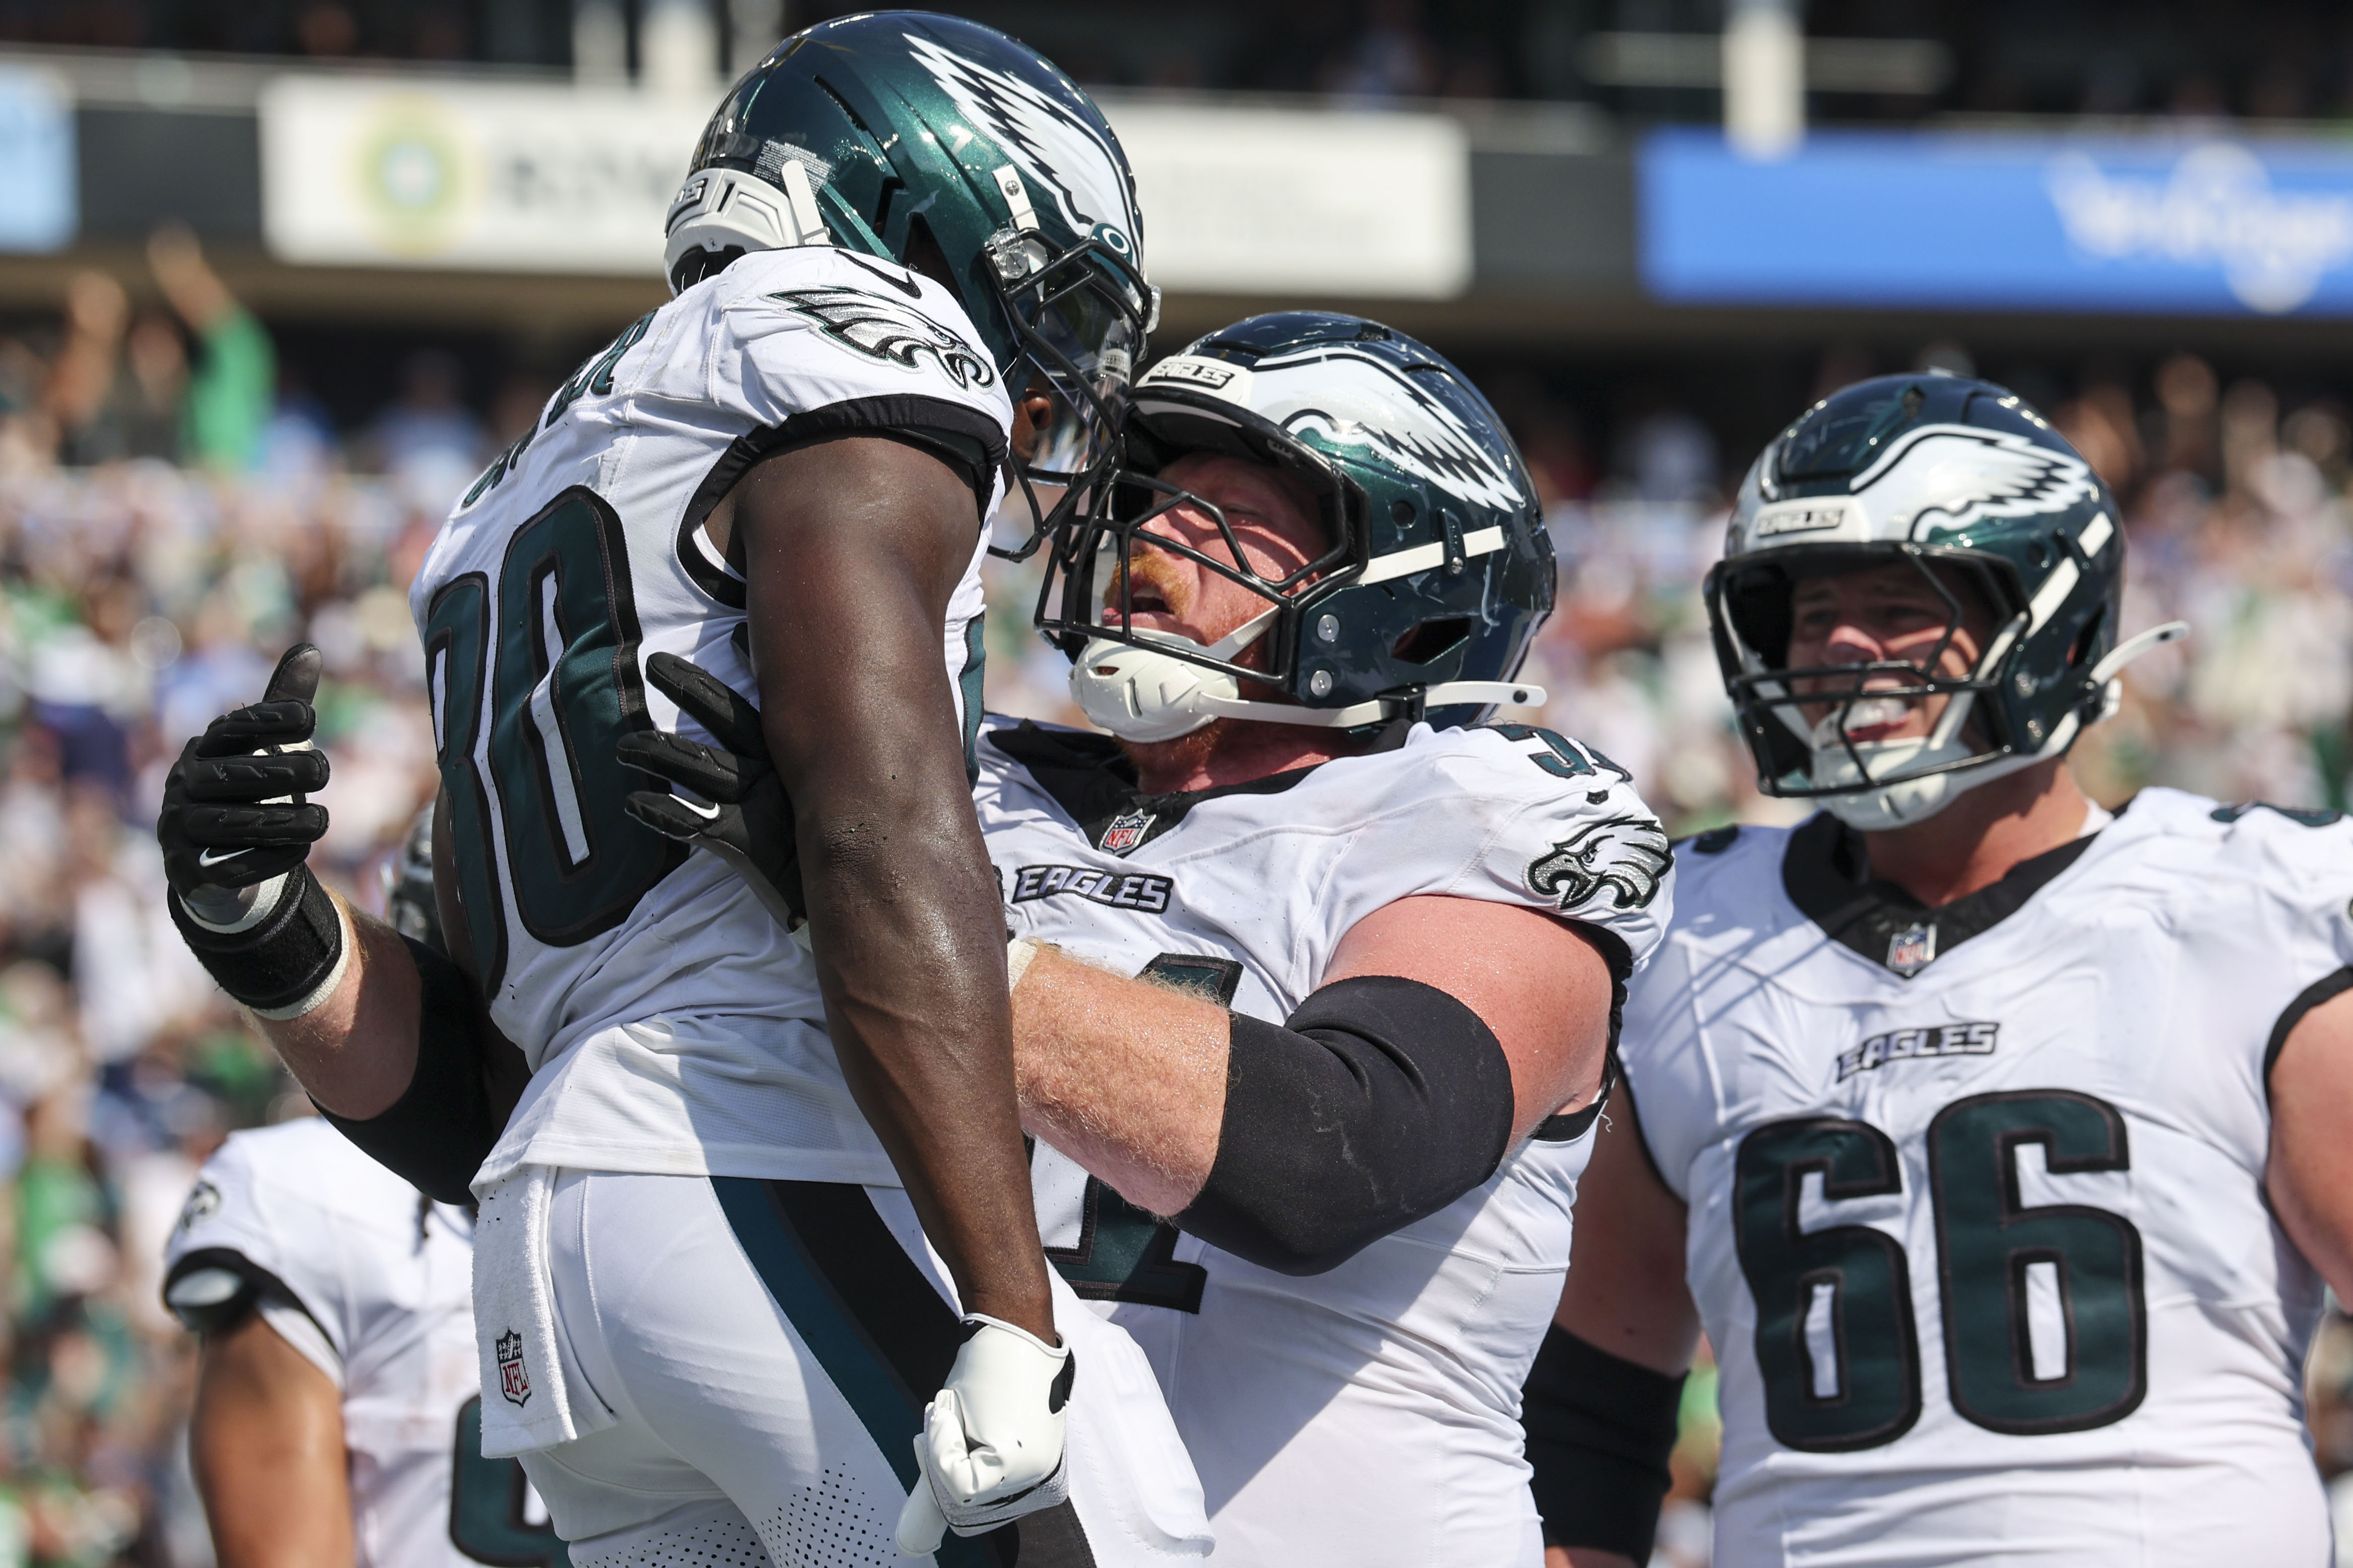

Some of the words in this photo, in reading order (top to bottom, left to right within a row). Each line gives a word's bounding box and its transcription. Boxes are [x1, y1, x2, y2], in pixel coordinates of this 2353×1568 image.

[1154, 362, 1231, 387] EAGLES
[1105, 828, 1136, 848] NFL
[1014, 866, 1170, 911] EAGLES
[1838, 1023, 1998, 1081] EAGLES
[1732, 1089, 2147, 1453] 66
[503, 1362, 528, 1396] NFL
